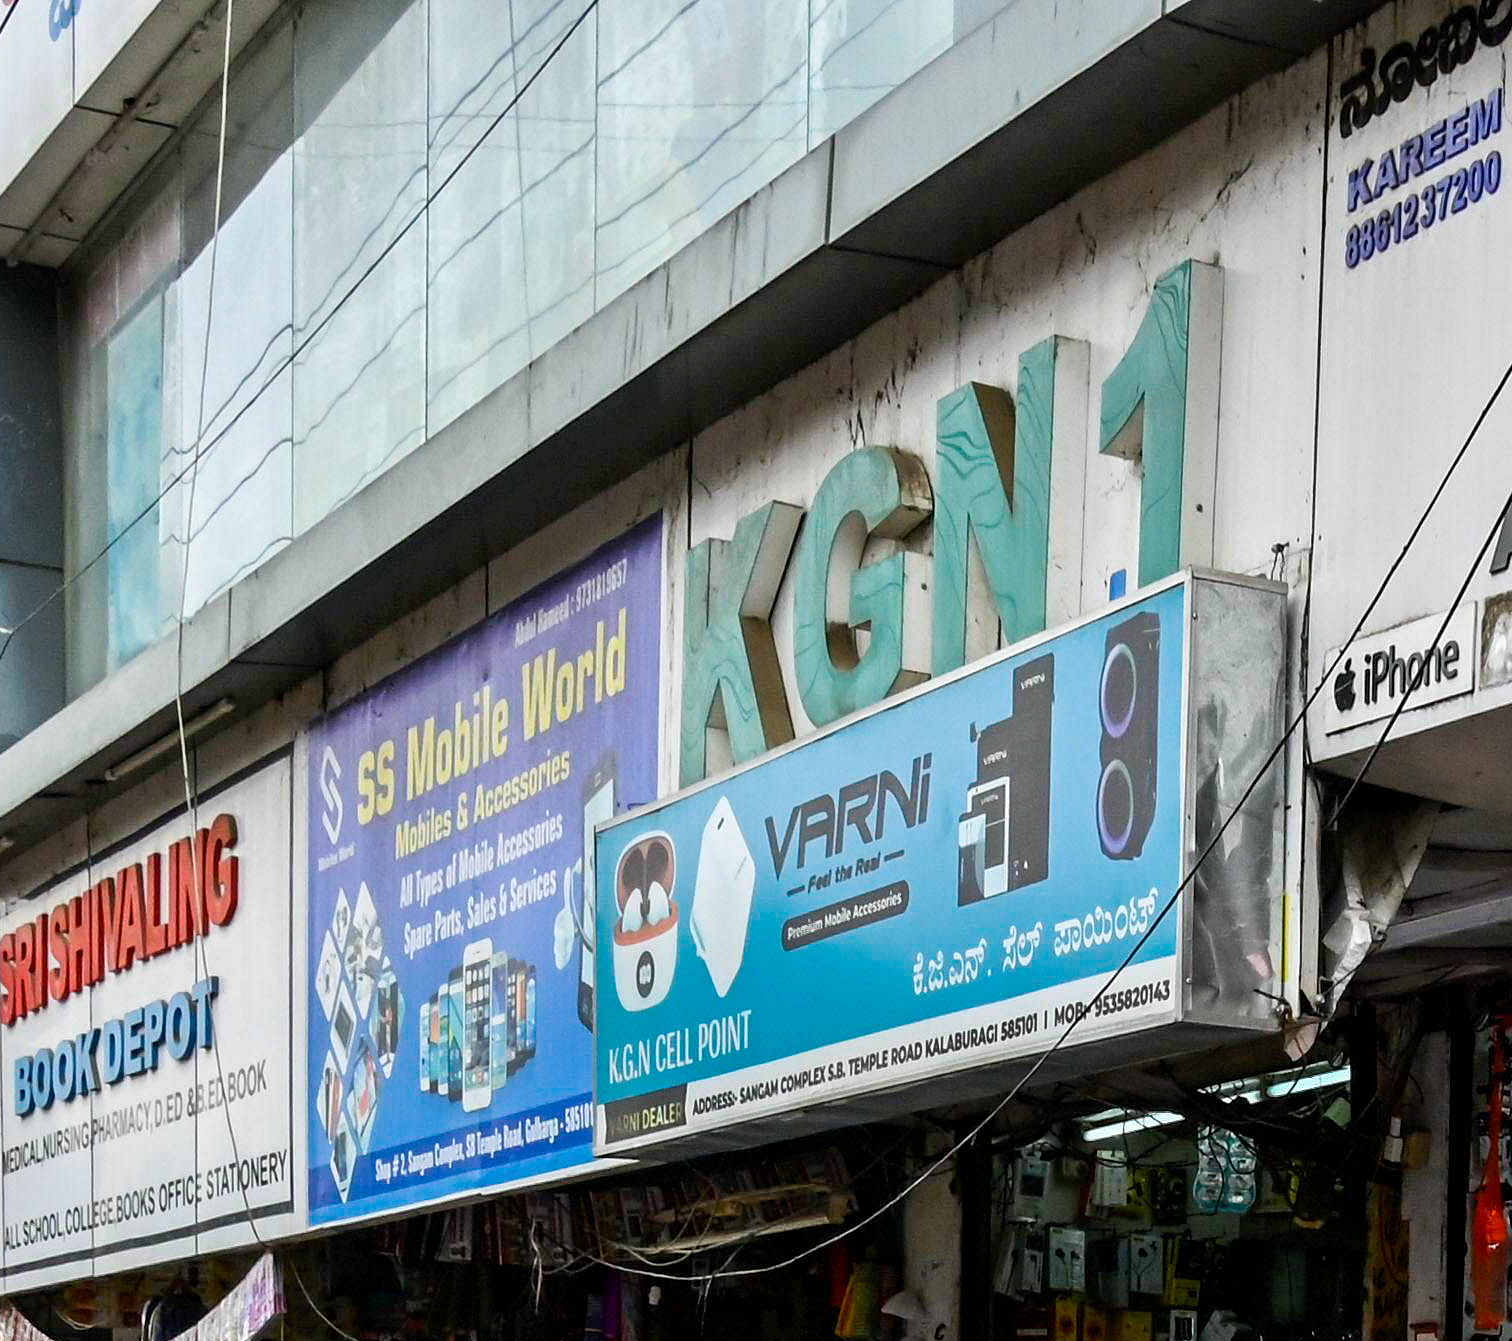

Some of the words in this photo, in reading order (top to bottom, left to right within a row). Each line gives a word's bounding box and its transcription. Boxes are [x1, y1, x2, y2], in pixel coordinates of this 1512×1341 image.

[1347, 87, 1503, 213] KAREEM
[1345, 151, 1502, 270] 8861237200
[679, 335, 1073, 788] KGN
[357, 741, 395, 827] SS
[406, 685, 510, 800] Mobile
[522, 608, 627, 742] World
[1362, 630, 1461, 706] iPhone
[394, 807, 452, 862] Mobiles
[456, 791, 468, 831] &
[473, 748, 571, 824] Accessories
[400, 876, 414, 908] All
[415, 866, 444, 907] Types
[445, 860, 457, 889] of
[458, 838, 494, 880] Mobile
[496, 809, 563, 866] Accessories
[807, 869, 832, 894] Feel
[834, 862, 853, 884] the
[855, 852, 881, 877] Real
[0, 913, 49, 1028] SRI
[49, 813, 238, 1001] SHIVALING
[403, 917, 433, 960] Spare
[434, 906, 464, 942] Parts,
[467, 893, 496, 929] Sales
[498, 885, 507, 913] &
[509, 866, 557, 910] Services
[787, 917, 823, 941] Premium
[824, 906, 851, 930] Mobile
[853, 891, 902, 921] Accessories
[14, 1026, 101, 1117] BOOK
[101, 977, 219, 1085] DEPOT
[228, 1060, 268, 1101] BOOK
[609, 1039, 650, 1084] K.G.N
[655, 1028, 693, 1073] CELL
[698, 1009, 752, 1062] POINT
[740, 1079, 778, 1104] SANGAM
[780, 1066, 826, 1092] COMPLEX
[828, 1062, 846, 1081] S.B.
[849, 1050, 888, 1077] TEMPLE
[891, 1042, 922, 1065] ROAD
[925, 1025, 998, 1056] KALABURAGI
[1000, 1013, 1038, 1041] 585101
[1095, 980, 1170, 1017] 9535820143
[375, 1156, 390, 1184] Shop
[565, 1101, 594, 1134] 585101
[642, 1103, 681, 1128] DEALER
[4, 1222, 20, 1250] ALL
[159, 1174, 201, 1211] OFFICE
[207, 1149, 287, 1199] STATIONERY
